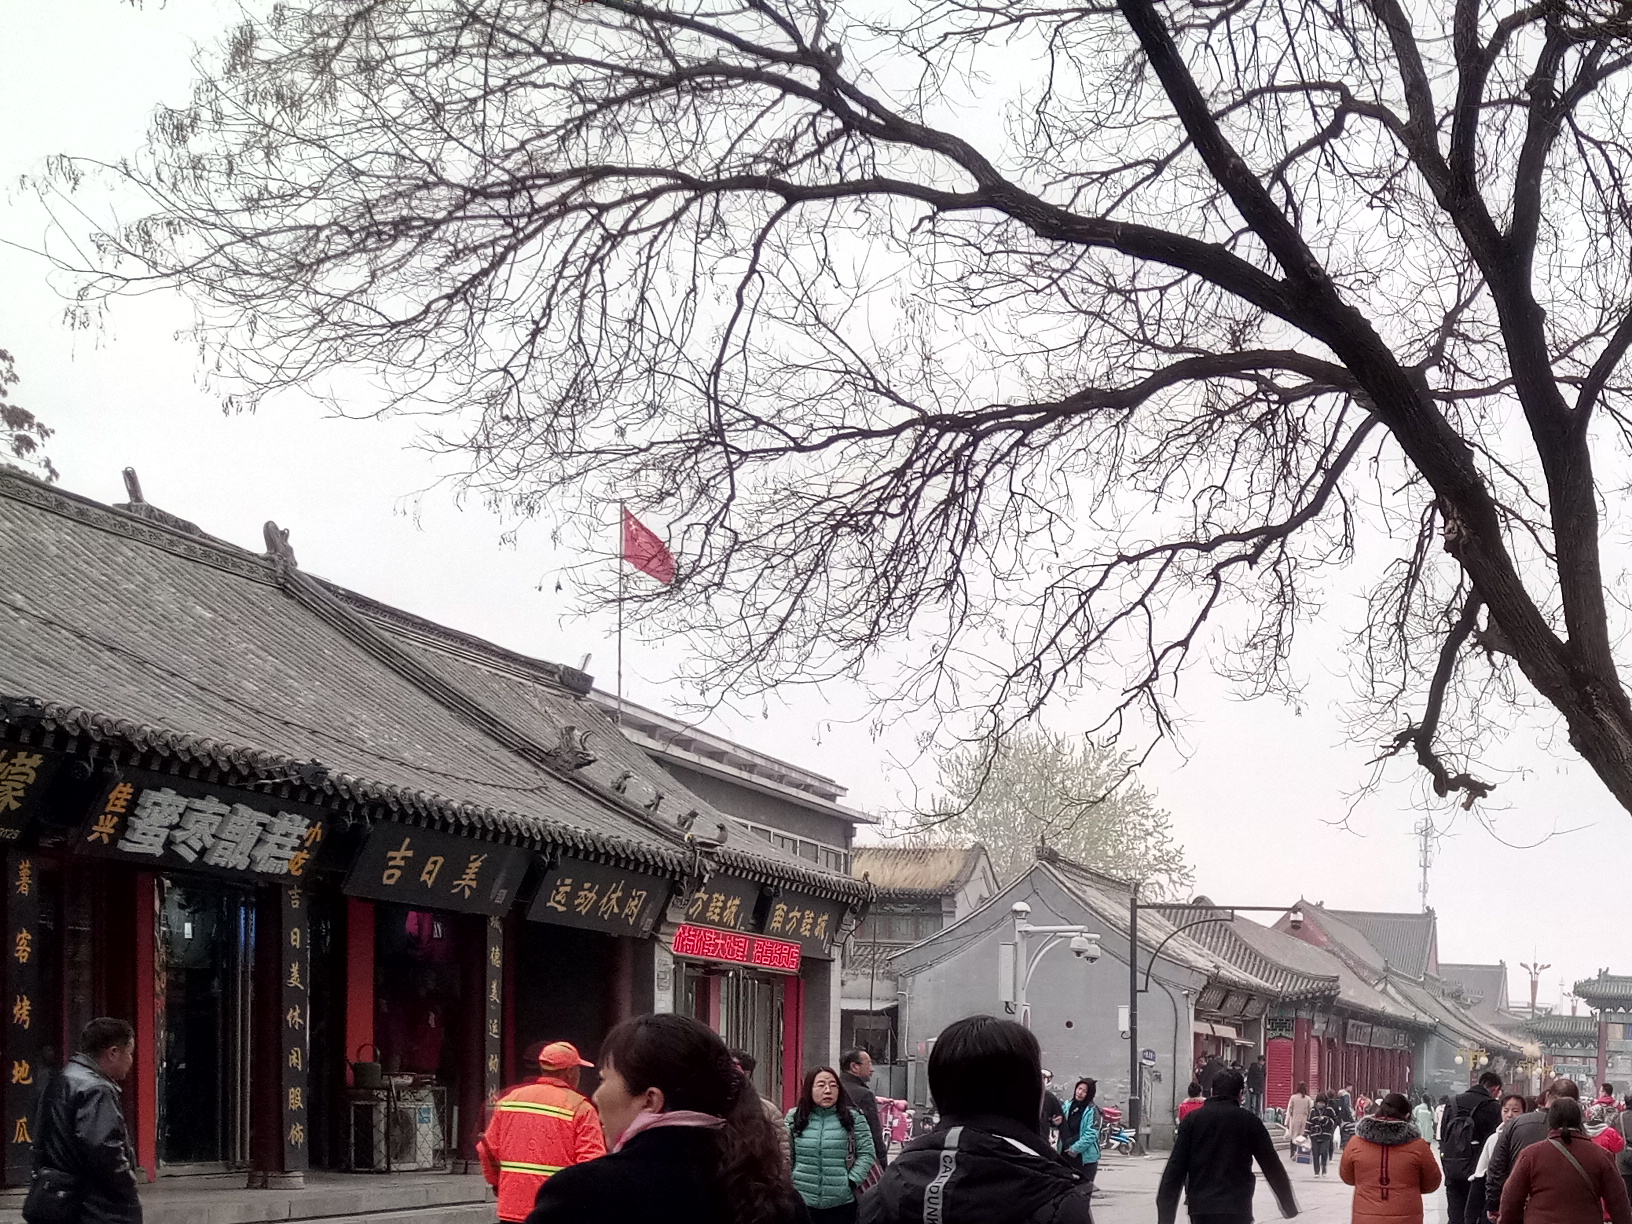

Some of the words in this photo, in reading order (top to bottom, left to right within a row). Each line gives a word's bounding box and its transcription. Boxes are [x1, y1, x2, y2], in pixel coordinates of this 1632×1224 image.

[87, 782, 134, 844] 佳兴
[288, 821, 322, 876] 小吃
[382, 837, 488, 899] 吉日美
[545, 878, 648, 926] 运动休闲
